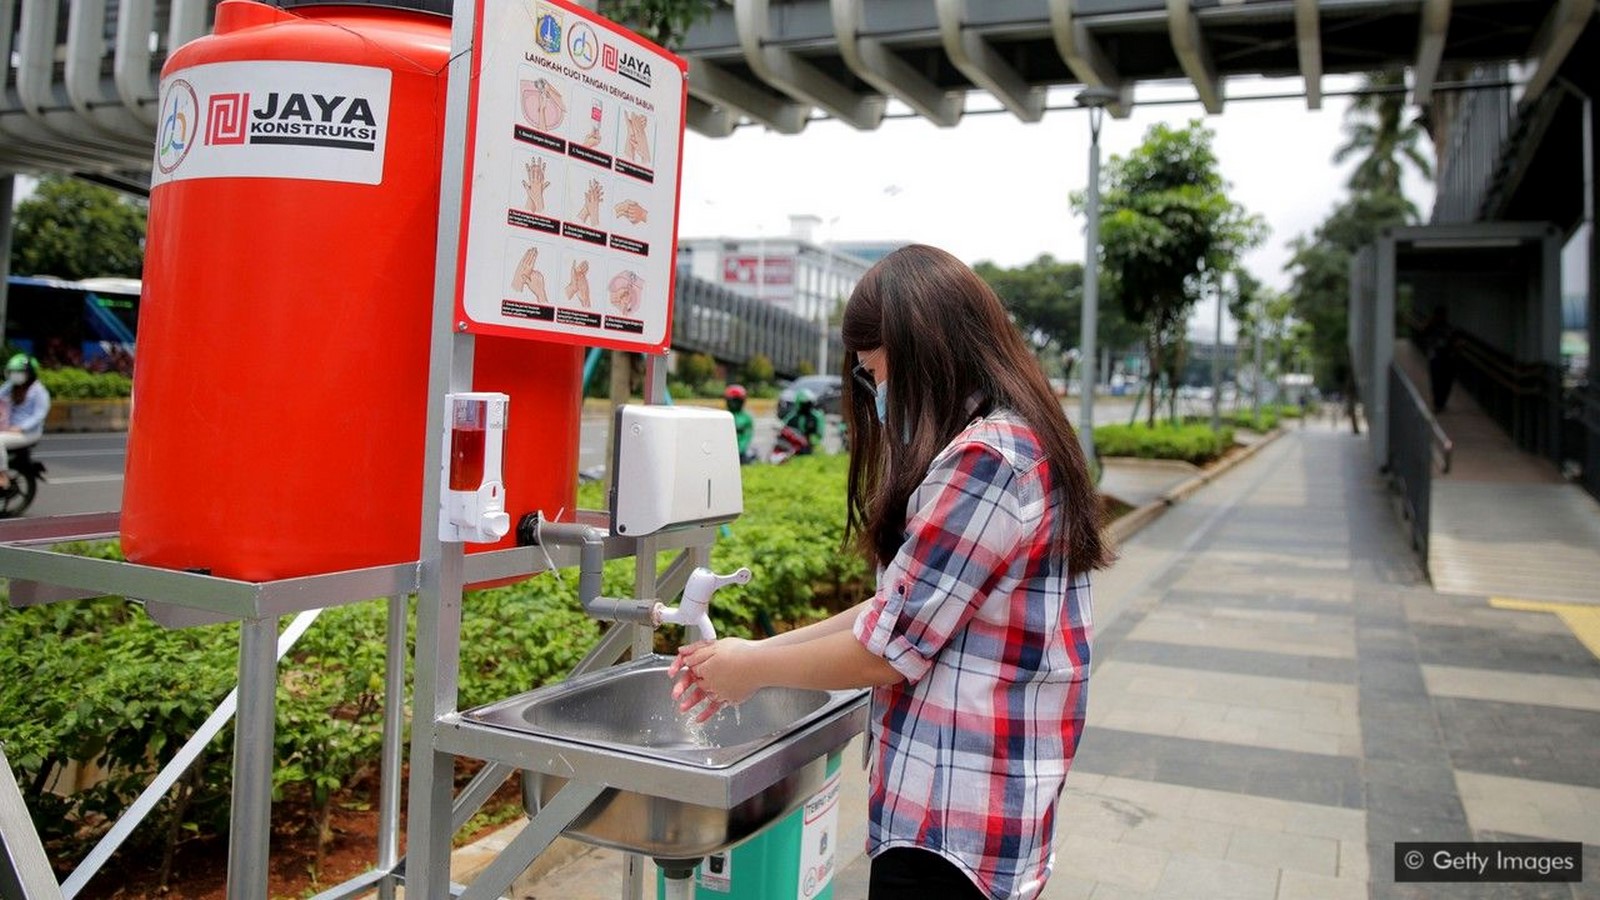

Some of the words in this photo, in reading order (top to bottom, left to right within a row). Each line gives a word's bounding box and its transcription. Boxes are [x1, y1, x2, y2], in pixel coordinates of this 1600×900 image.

[619, 53, 652, 77] JAYA
[525, 52, 562, 73] LANGKAH
[563, 67, 581, 81] CUCI
[582, 75, 608, 93] TANGAN
[609, 85, 635, 103] DENGAN
[635, 98, 655, 112] SABUN
[253, 92, 377, 126] JAYA
[250, 122, 377, 140] KONSTRUKSI
